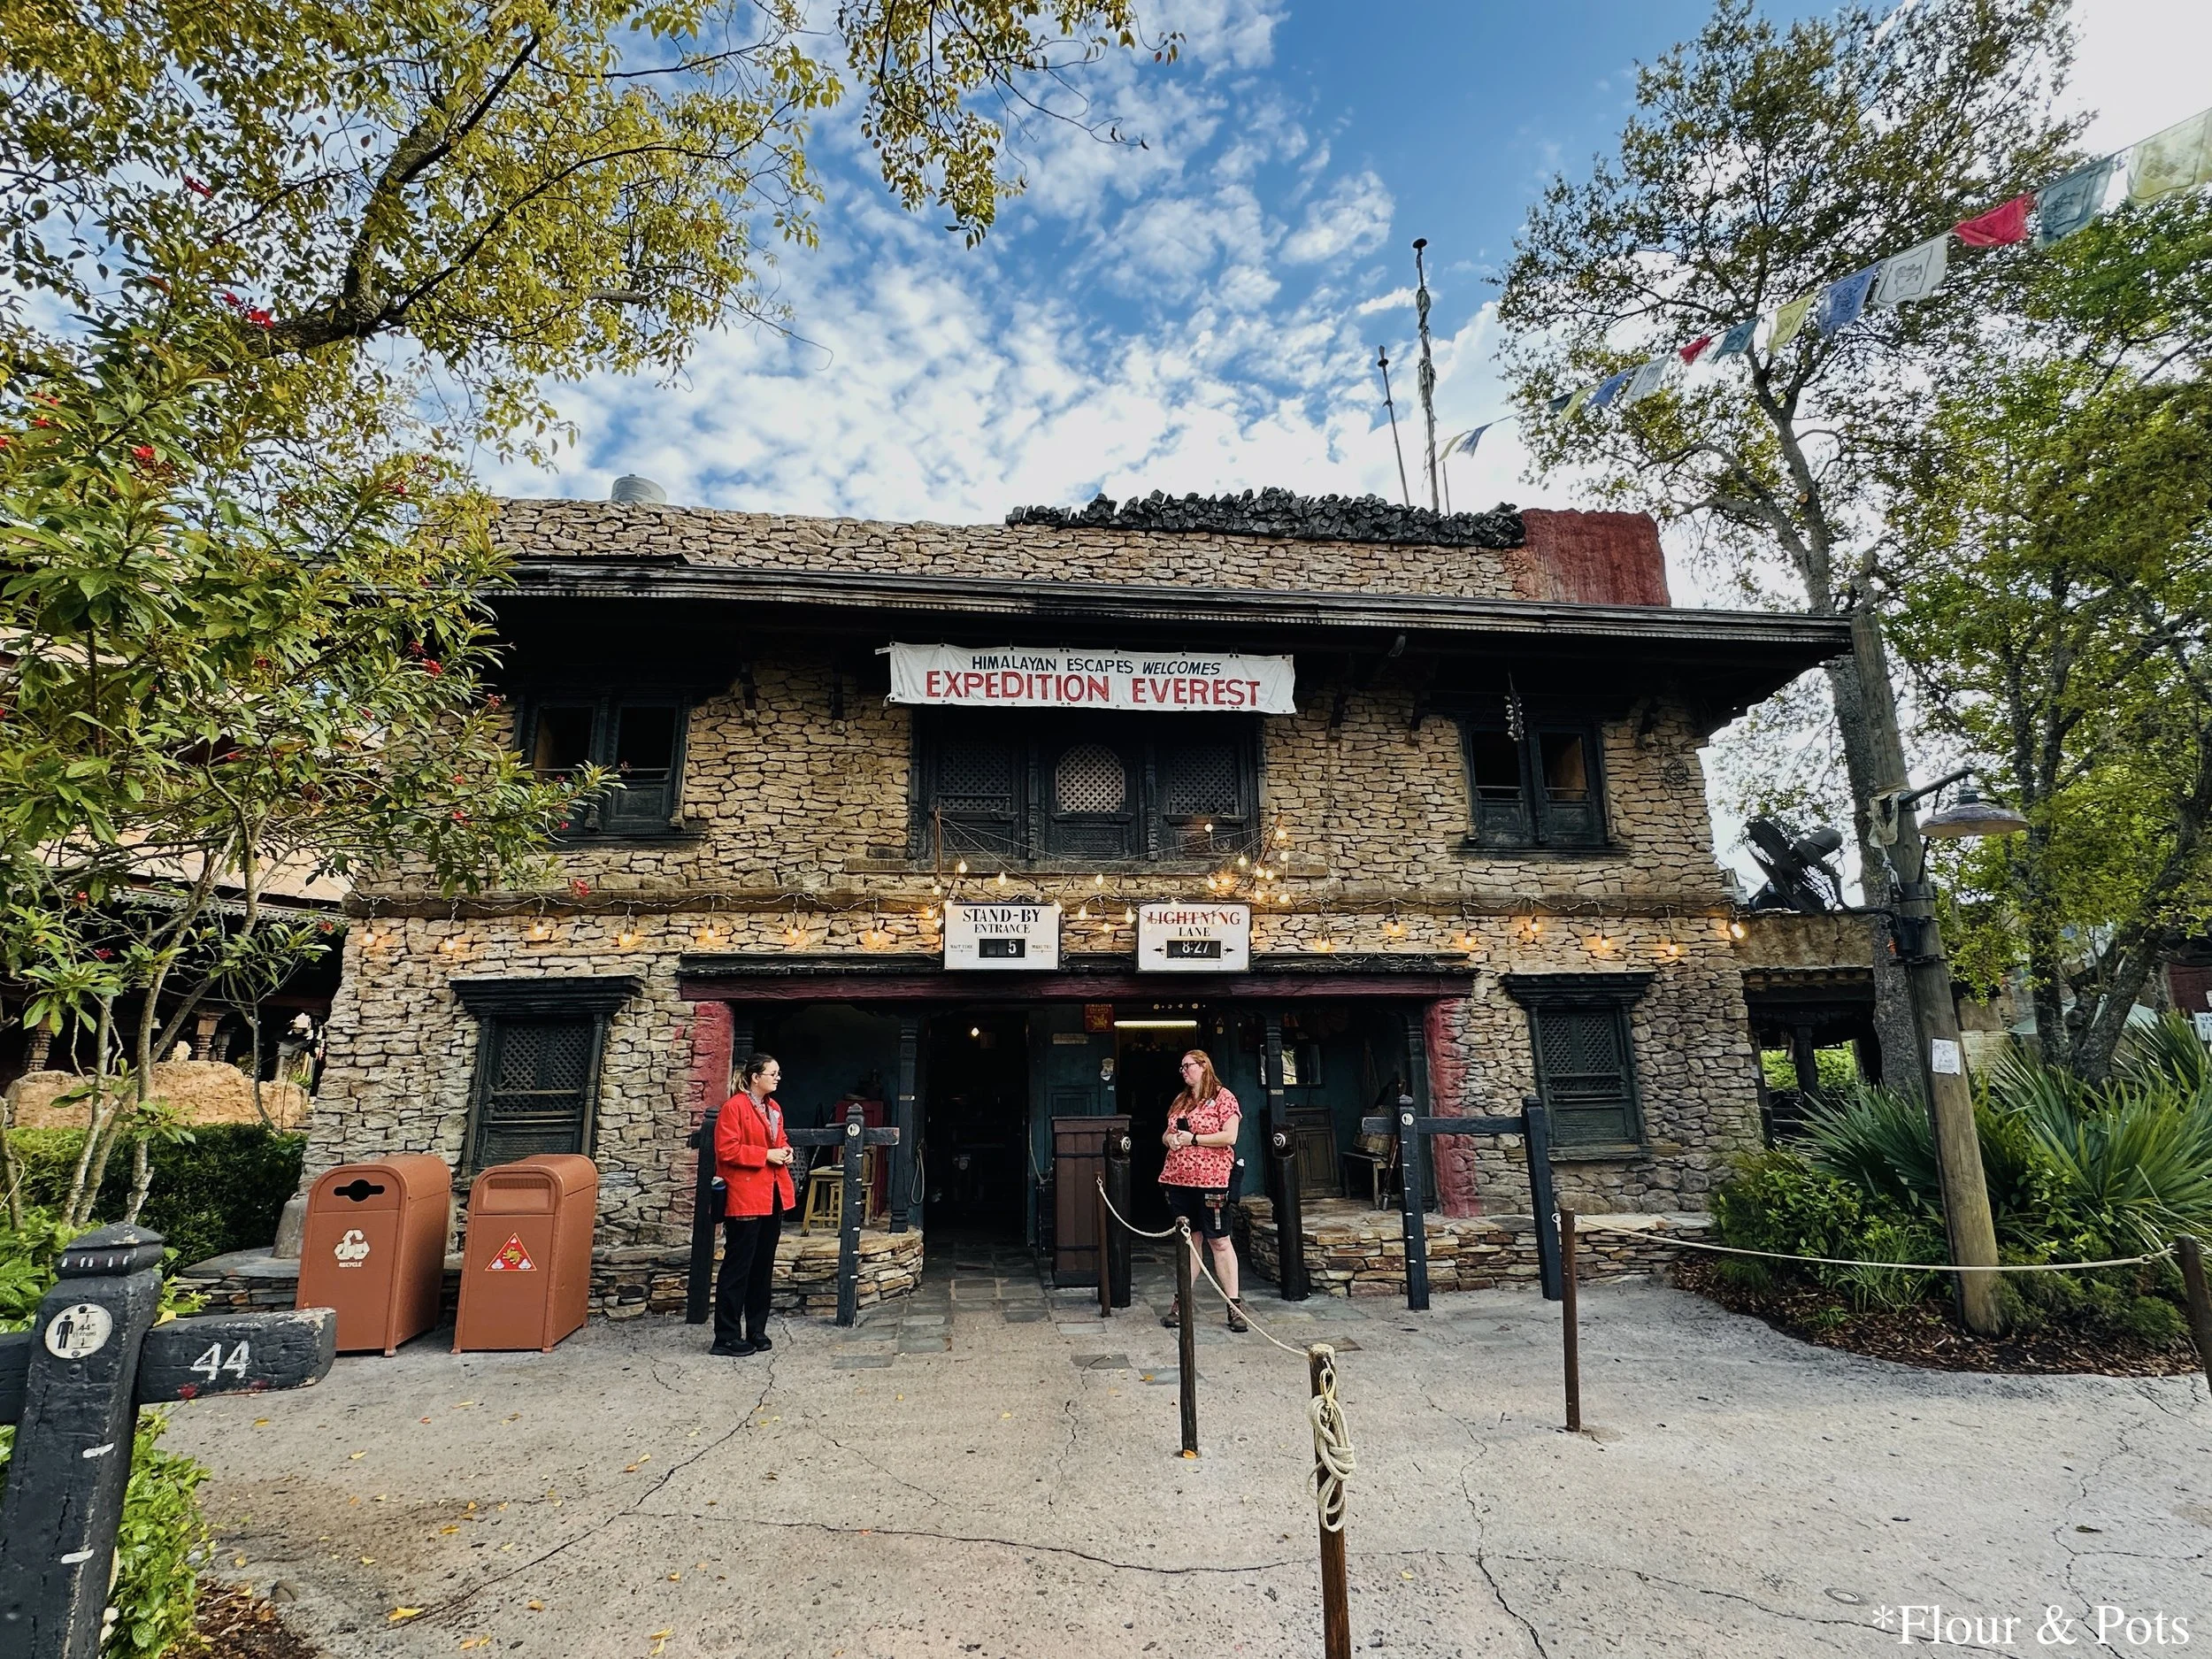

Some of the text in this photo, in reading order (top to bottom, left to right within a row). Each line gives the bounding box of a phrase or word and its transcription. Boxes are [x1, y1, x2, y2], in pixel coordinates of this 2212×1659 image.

[972, 656, 1222, 675] HIMALAYAN ESCAPES WELCOMES
[926, 671, 1260, 706] EXPEDITION EVEREST
[963, 908, 1041, 922] STAND-BY
[1149, 911, 1240, 925] LIGHTNING
[974, 924, 1031, 933] ENTRANCE
[1179, 927, 1210, 936] LANE
[1008, 940, 1017, 954] 5
[1182, 941, 1210, 954] 8:27
[189, 1340, 252, 1380] 44
